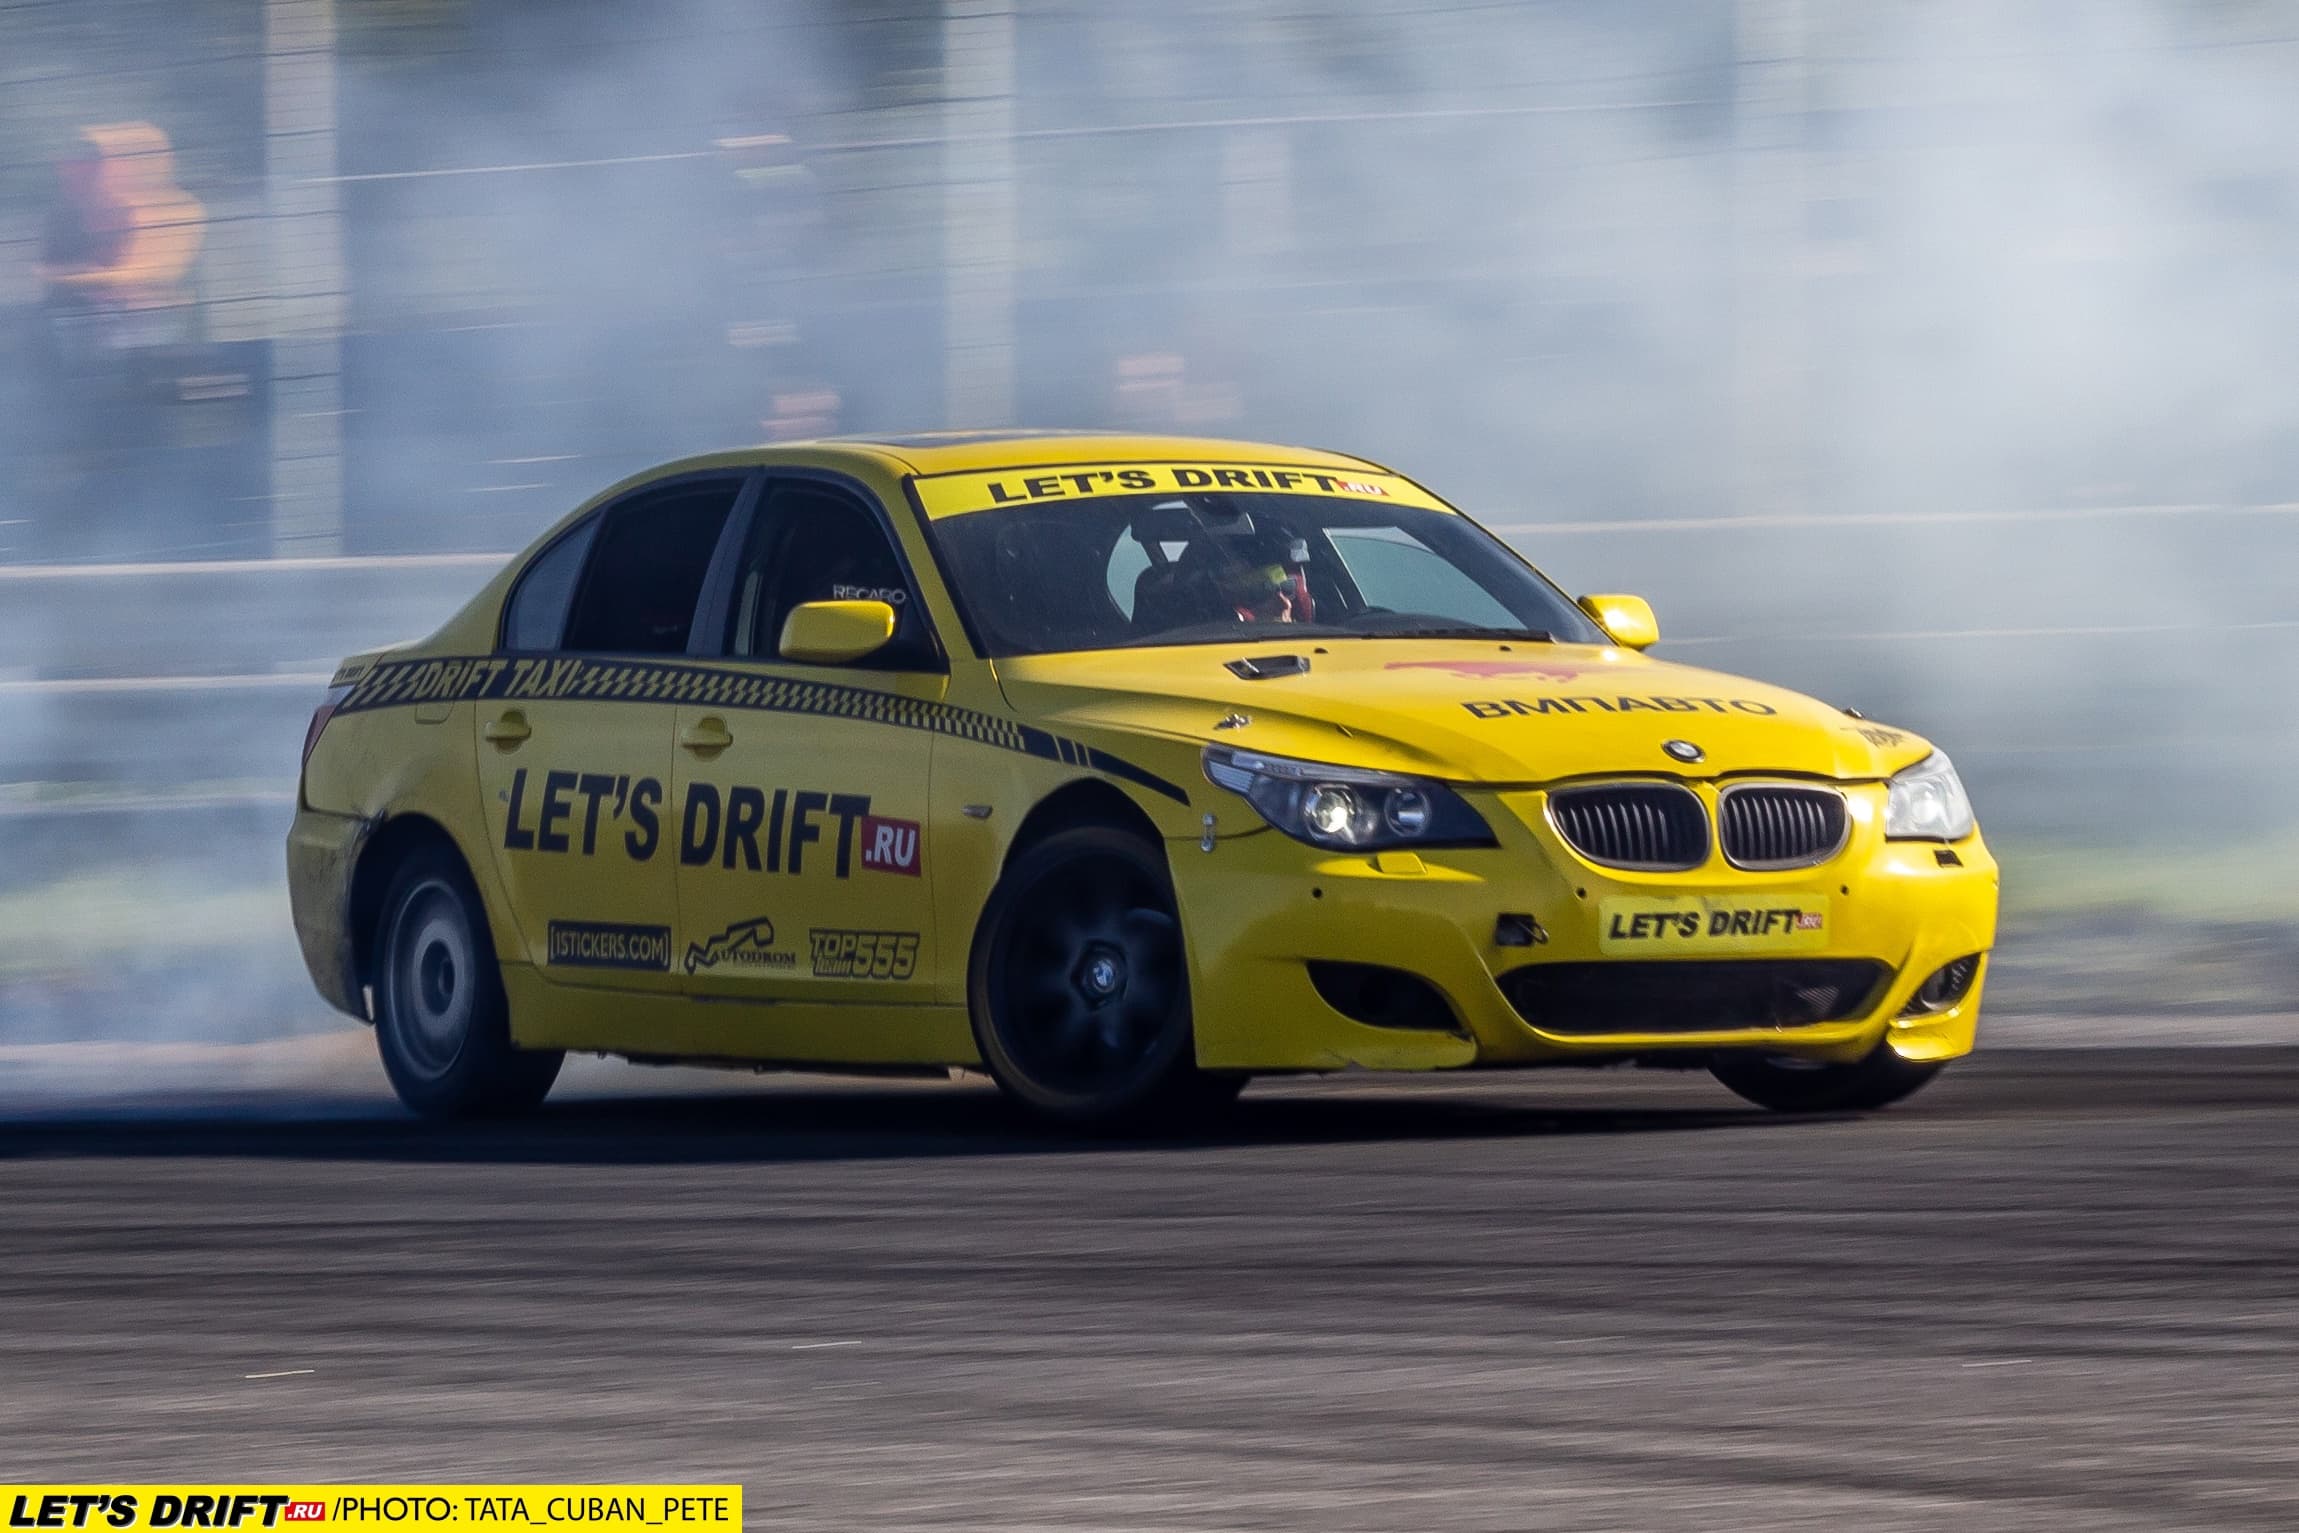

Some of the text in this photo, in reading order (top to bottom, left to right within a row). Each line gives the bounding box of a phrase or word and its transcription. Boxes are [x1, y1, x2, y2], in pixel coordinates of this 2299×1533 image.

[988, 470, 1155, 503] LET'S
[416, 659, 583, 698] DRIFT TAXI
[504, 768, 663, 862] LET'S
[1609, 911, 1700, 940] LET'S
